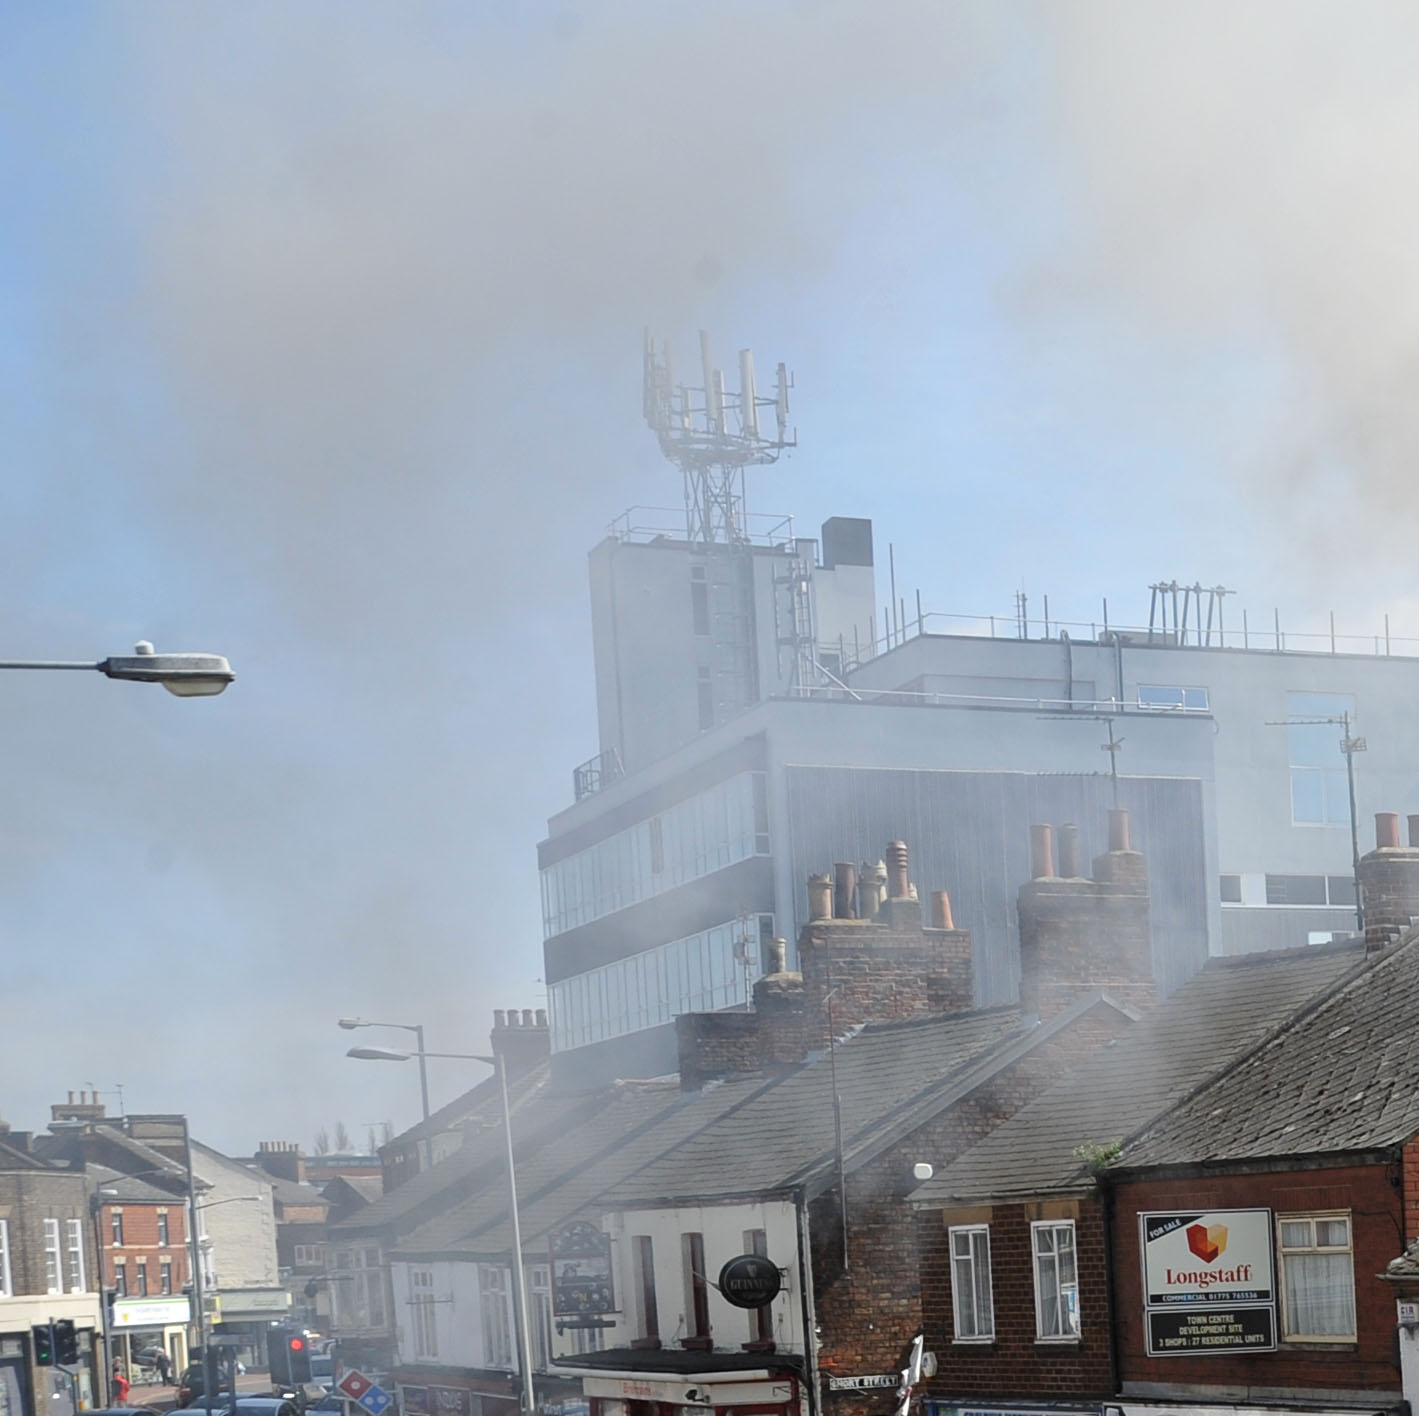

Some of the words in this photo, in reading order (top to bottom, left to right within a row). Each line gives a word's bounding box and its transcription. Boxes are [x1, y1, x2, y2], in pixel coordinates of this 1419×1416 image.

[1149, 1227, 1164, 1239] FOR
[1164, 1219, 1181, 1231] SALE
[1165, 1264, 1253, 1288] Longstaff
[1162, 1293, 1207, 1302] COMMERCIAL
[1209, 1293, 1230, 1301] 01775
[1187, 1315, 1207, 1325] TOWN
[1208, 1314, 1234, 1324] CENTRE
[1179, 1325, 1227, 1335] DEVELOPMENT
[1228, 1324, 1243, 1333] SITE
[1165, 1338, 1187, 1347] SHOPS
[1202, 1335, 1243, 1345] RESIDENTIAL
[1244, 1334, 1264, 1343] UNITS
[863, 1375, 898, 1387] STREET
